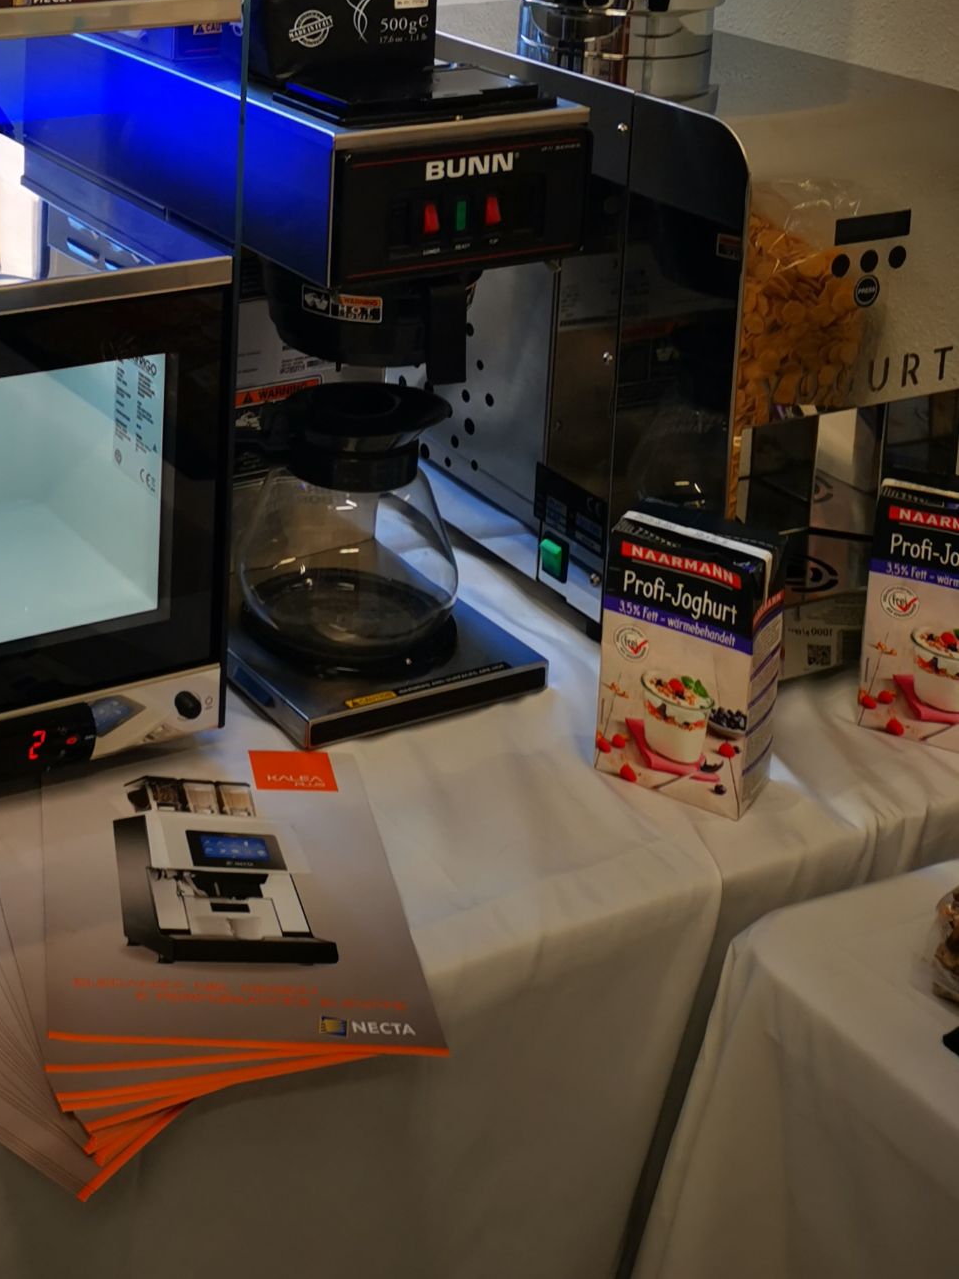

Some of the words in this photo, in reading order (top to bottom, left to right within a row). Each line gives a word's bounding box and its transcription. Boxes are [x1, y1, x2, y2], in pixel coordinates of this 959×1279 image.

[425, 151, 514, 182] BUNN
[631, 544, 735, 585] NAARMANN
[623, 569, 738, 626] Profi-Joghurt
[642, 605, 659, 622] Fett
[667, 616, 737, 648] wärmebehandelt
[28, 729, 47, 761] 2
[267, 773, 323, 783] KALEA
[351, 1019, 417, 1037] NECTA
